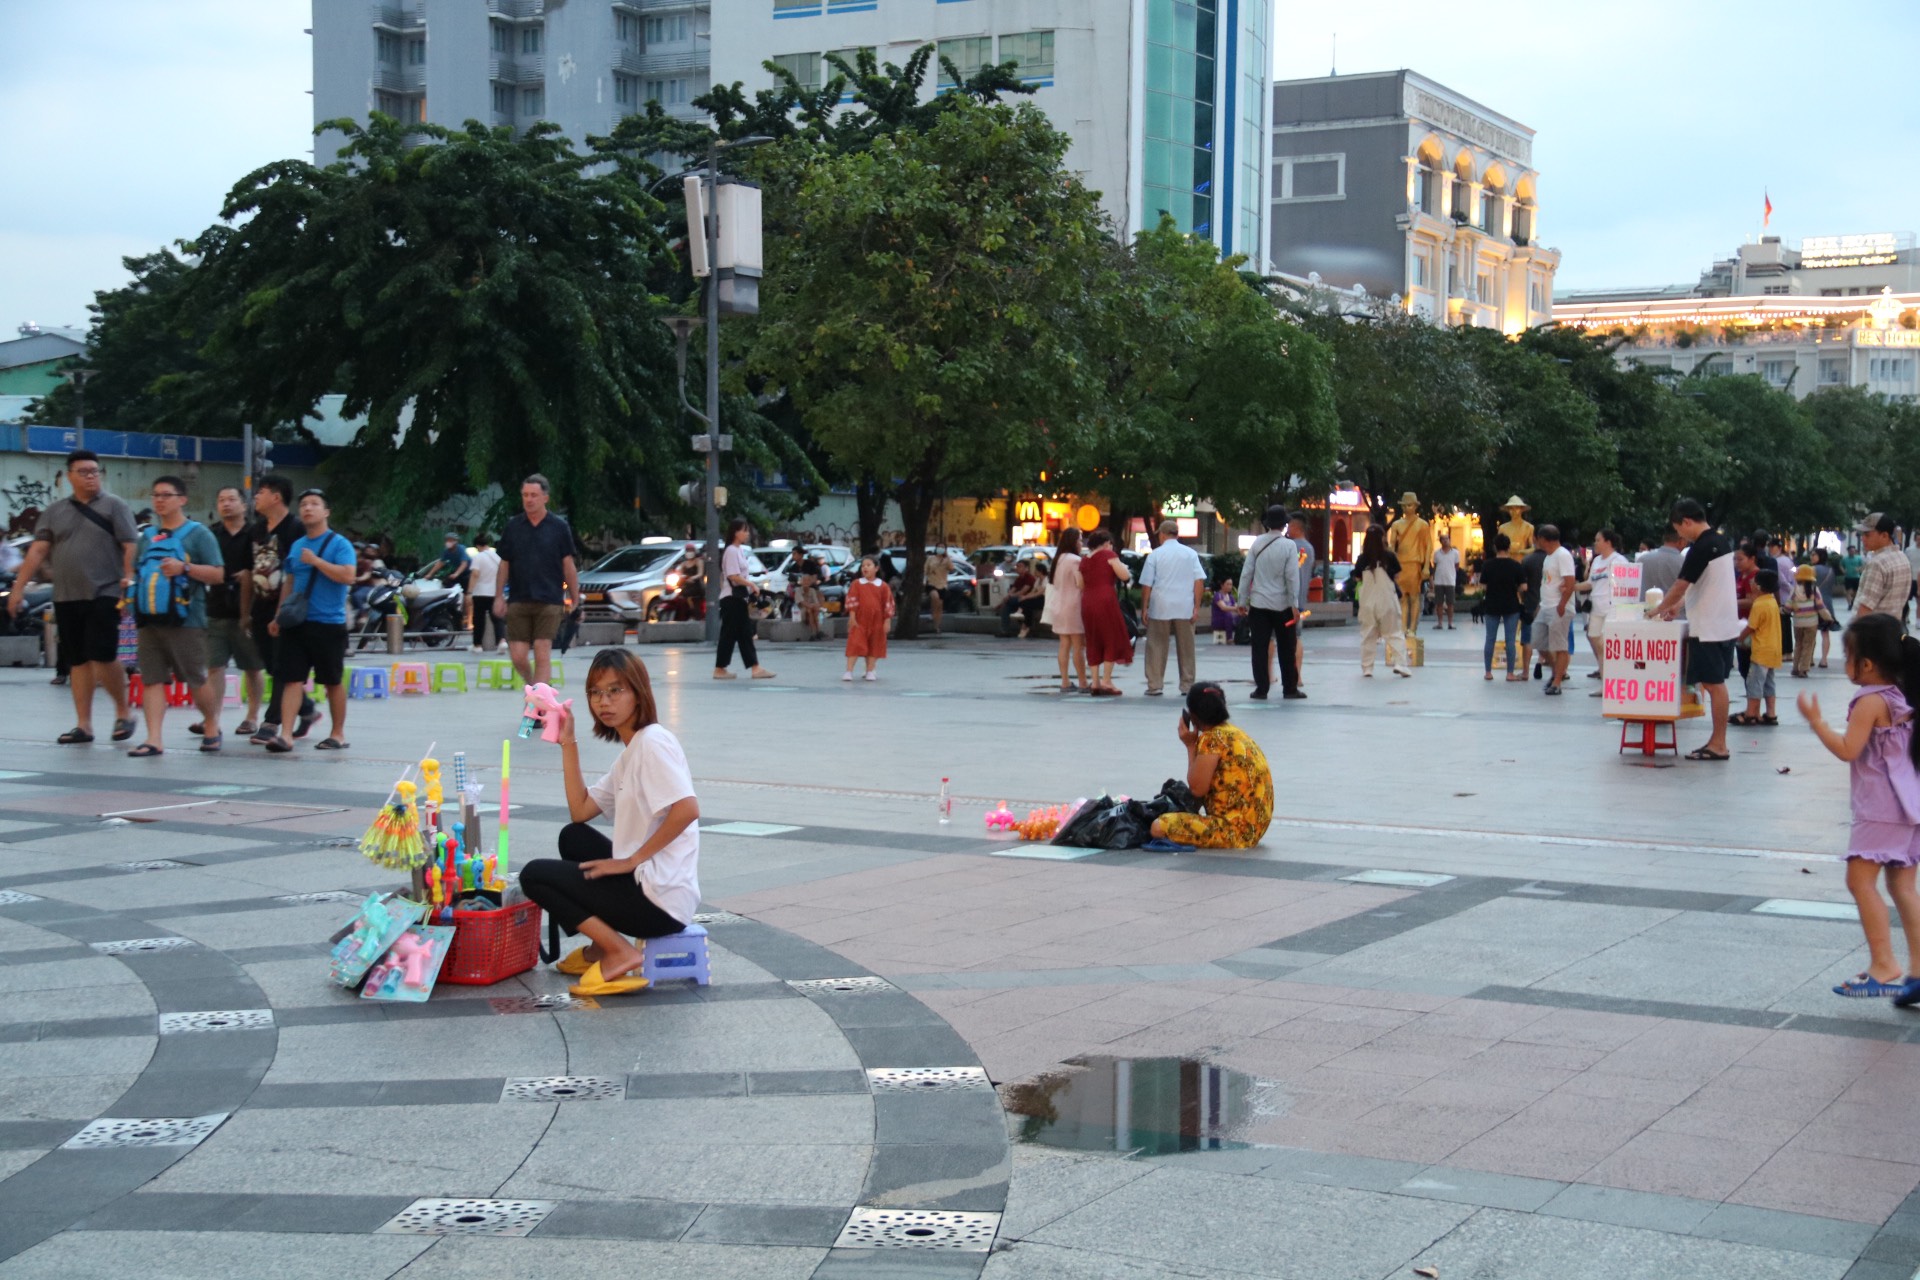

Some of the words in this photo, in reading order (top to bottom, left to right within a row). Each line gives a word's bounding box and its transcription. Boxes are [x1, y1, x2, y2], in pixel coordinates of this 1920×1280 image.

[1857, 330, 1882, 345] REX
[1606, 633, 1620, 660] BÒ
[1625, 633, 1643, 660] BÍA
[1647, 639, 1677, 664] NGỌT
[1604, 678, 1638, 704] KẸO
[1645, 673, 1676, 702] CHỈ
